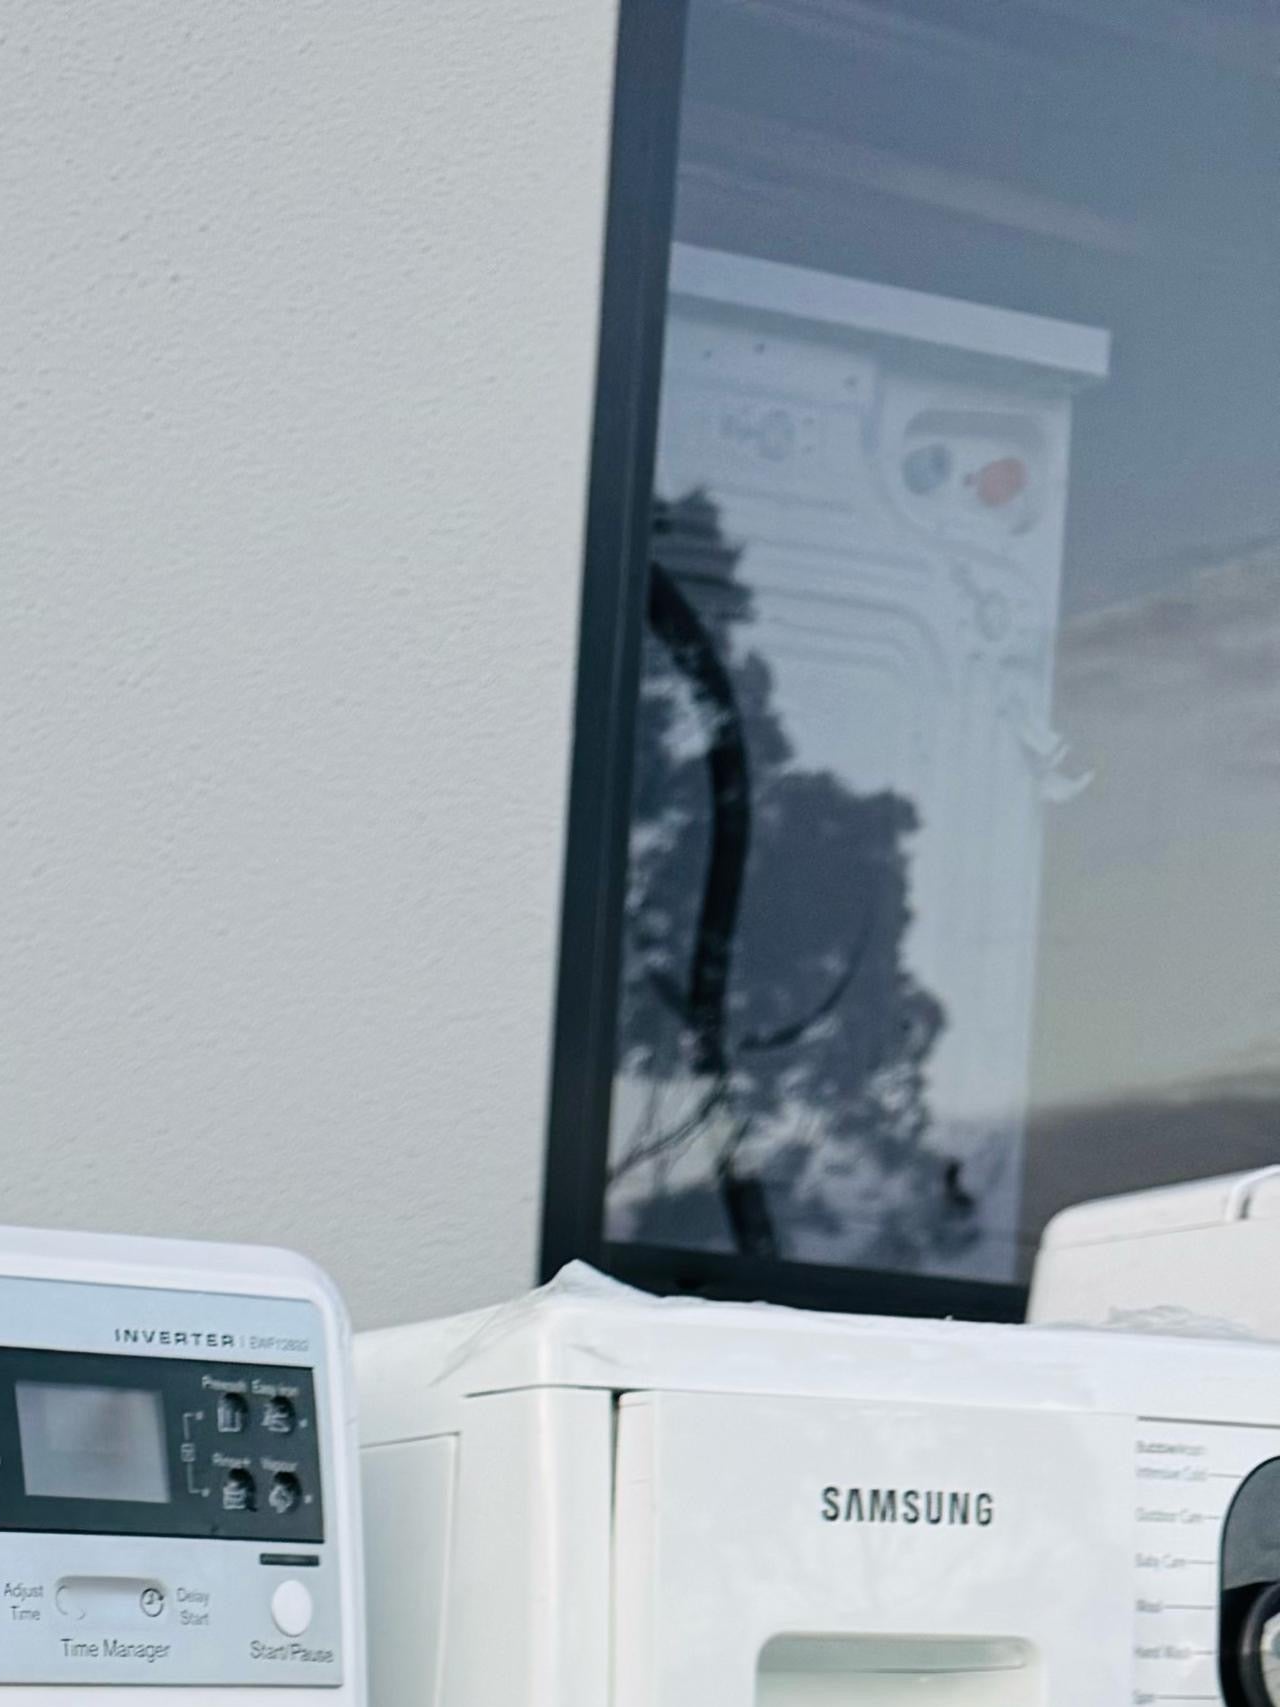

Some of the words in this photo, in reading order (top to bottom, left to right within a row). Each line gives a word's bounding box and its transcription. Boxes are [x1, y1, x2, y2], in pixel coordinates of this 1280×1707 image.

[114, 1328, 235, 1348] INVERTER
[821, 1485, 995, 1527] SAMSUNG
[10, 1605, 41, 1621] Time
[60, 1637, 100, 1658] Time
[103, 1638, 172, 1664] Manager
